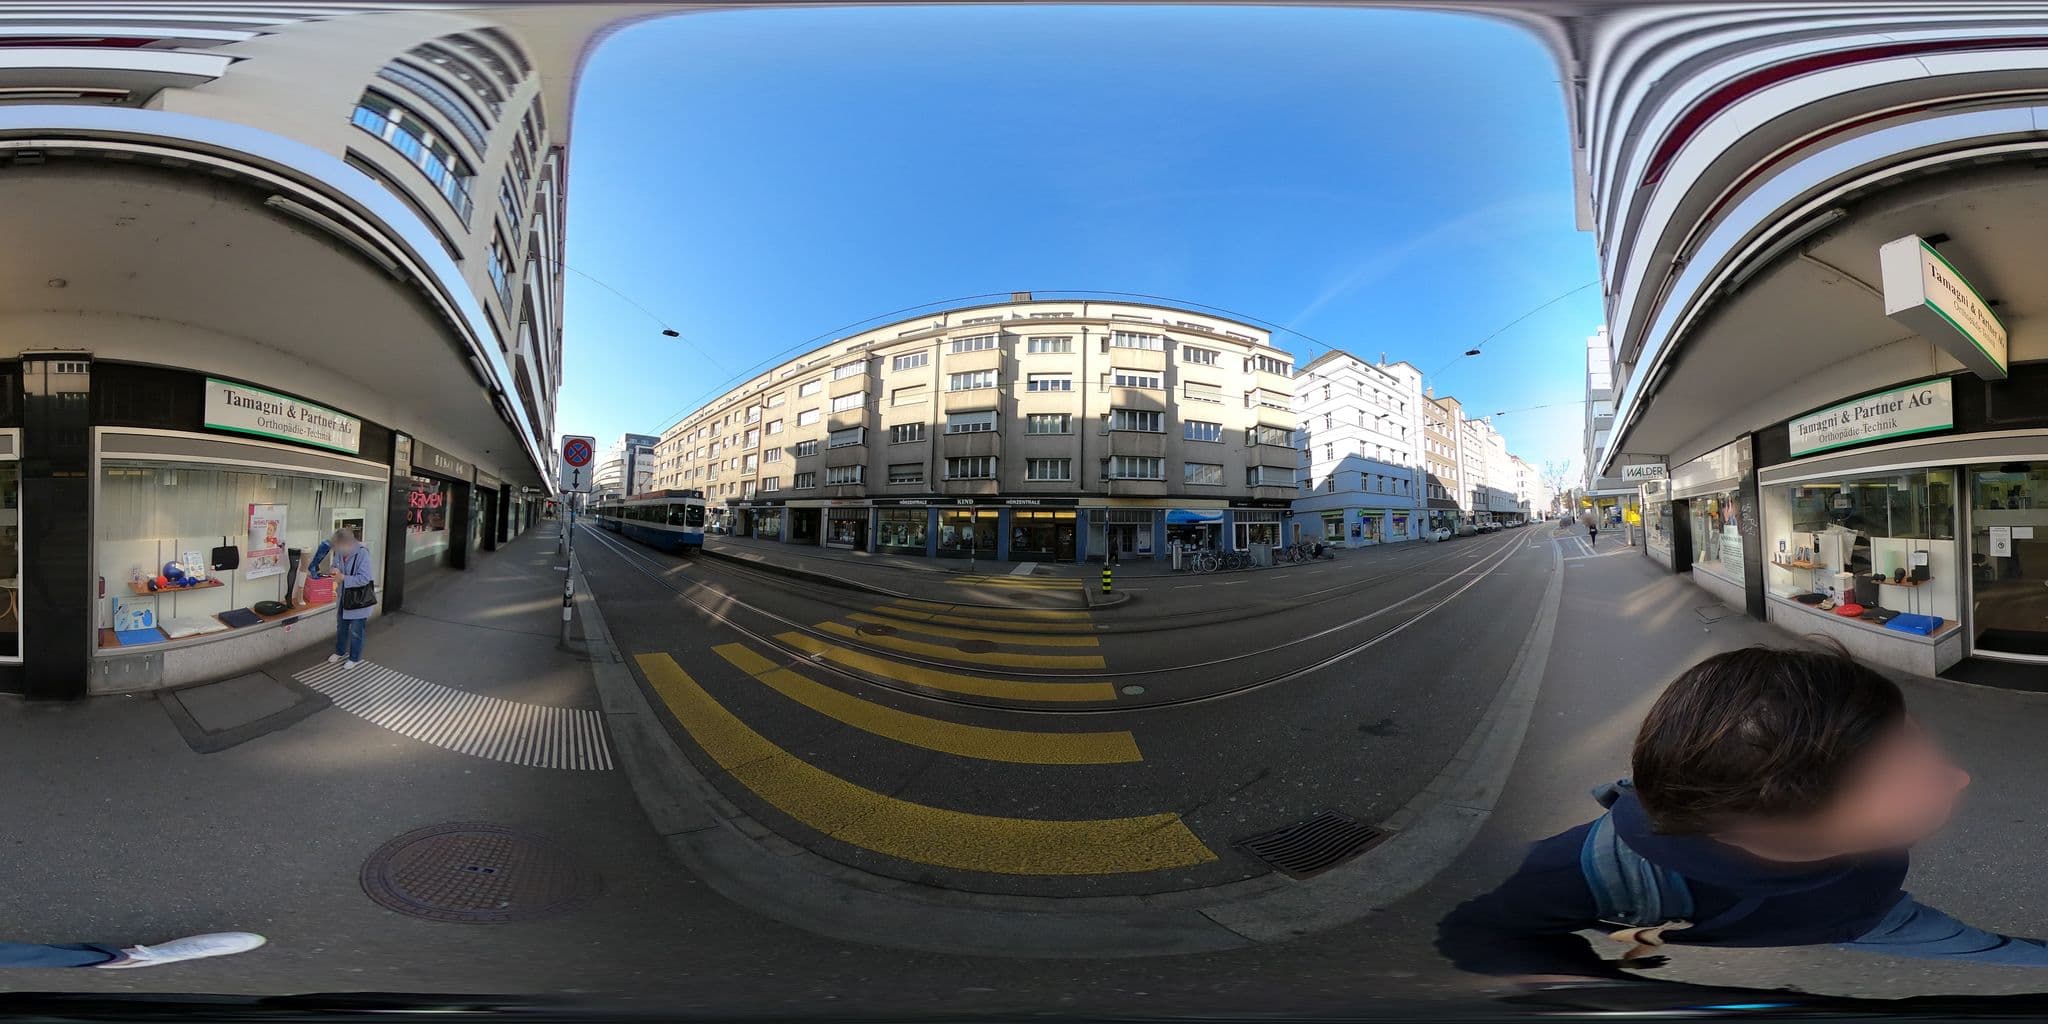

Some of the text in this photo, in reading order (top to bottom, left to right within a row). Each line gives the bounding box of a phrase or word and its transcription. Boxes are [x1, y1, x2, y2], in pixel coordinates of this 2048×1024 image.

[1928, 262, 1969, 308] Tamagni
[1970, 302, 1977, 316] &
[223, 389, 352, 434] Tamagni & Partner AG
[1797, 389, 1933, 436] Tamagni & Partner AG
[1818, 417, 1898, 444] Orthopädie-Technik
[1626, 466, 1663, 477] WALDER
